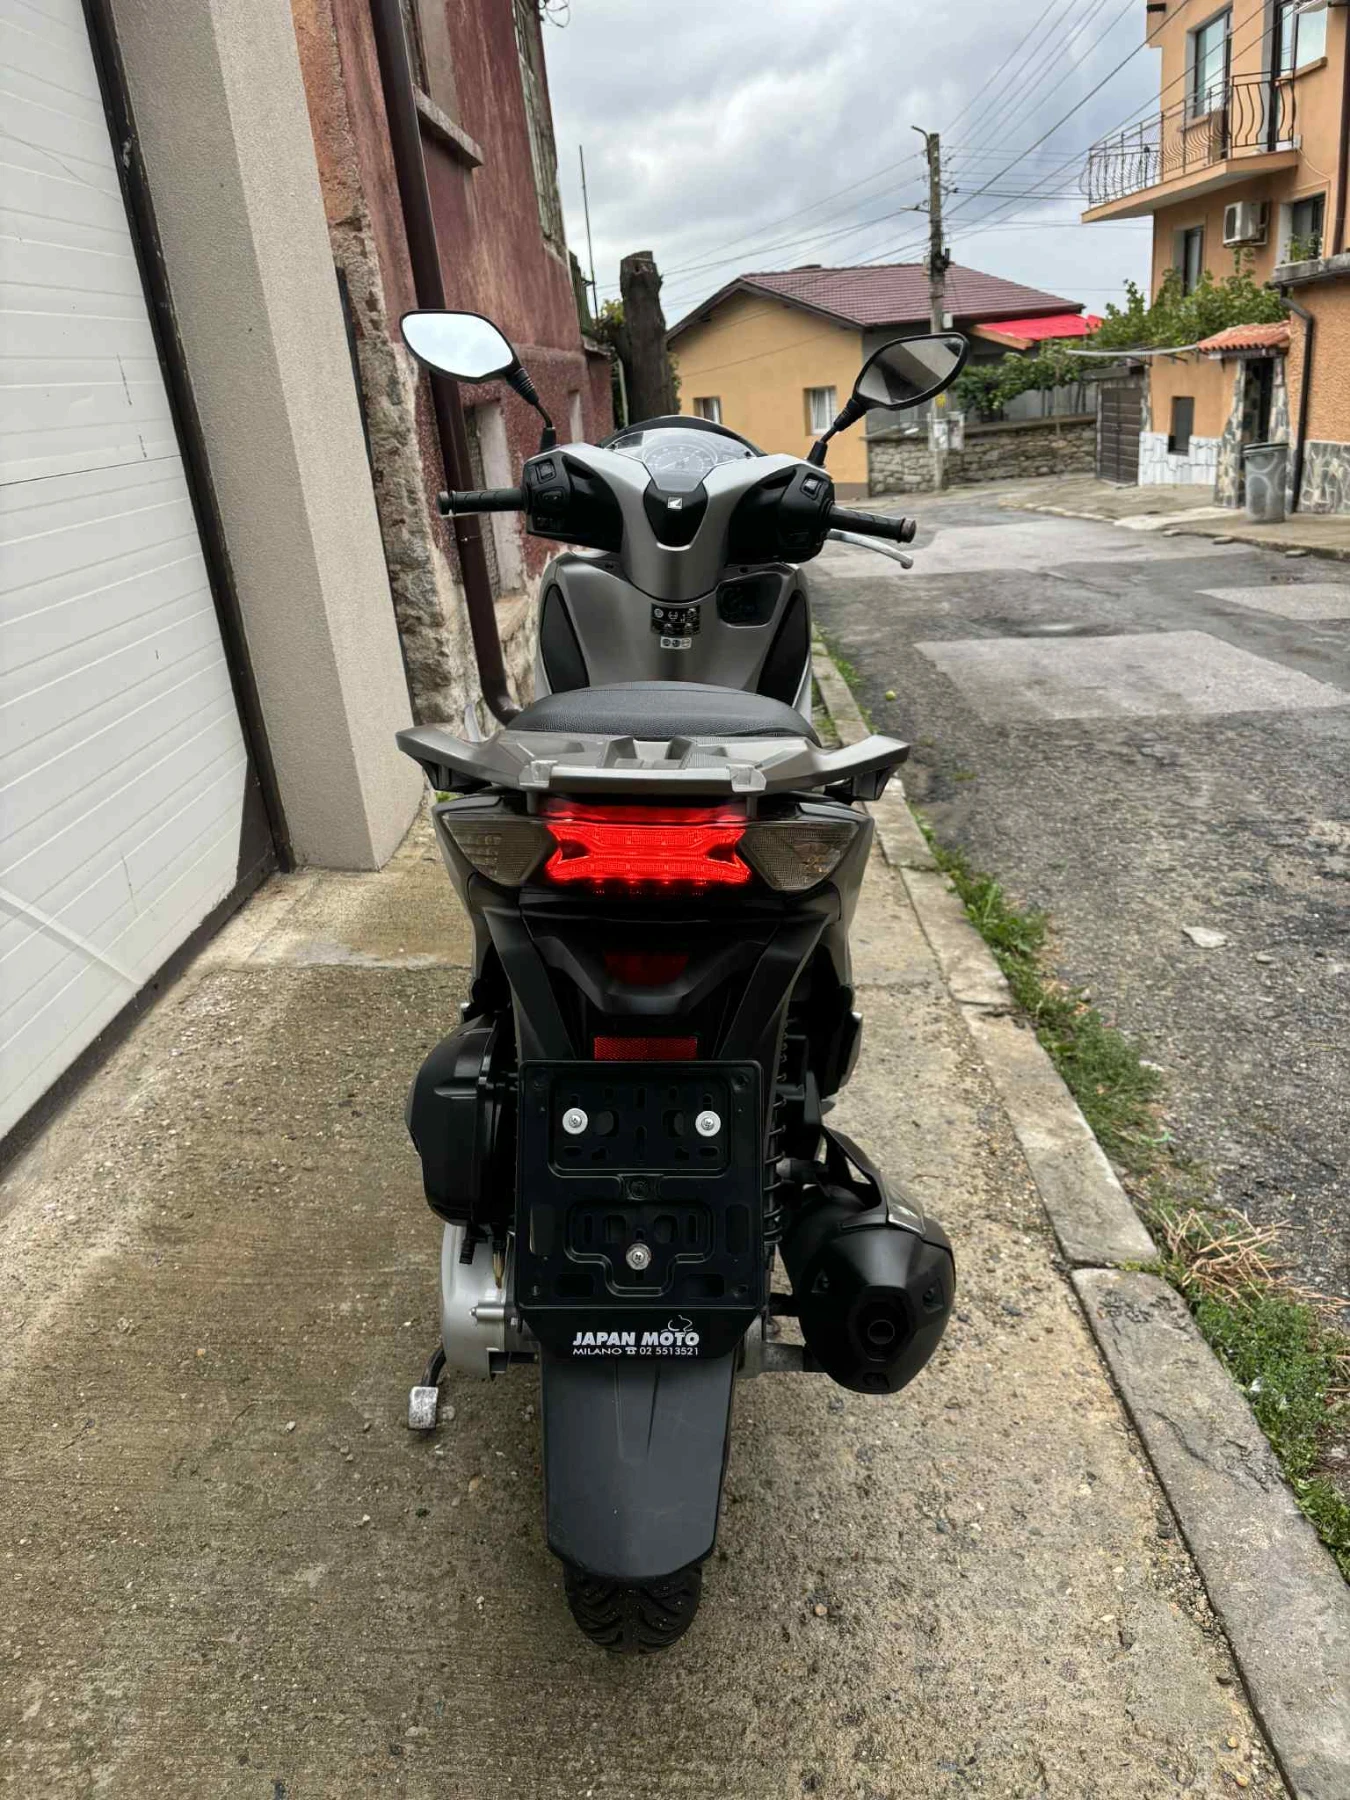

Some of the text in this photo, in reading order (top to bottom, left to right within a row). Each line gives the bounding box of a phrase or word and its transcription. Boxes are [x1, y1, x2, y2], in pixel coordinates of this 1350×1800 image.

[572, 1332, 700, 1346] JAPAN MOTO
[572, 1347, 699, 1356] MILANO 02 5513521
